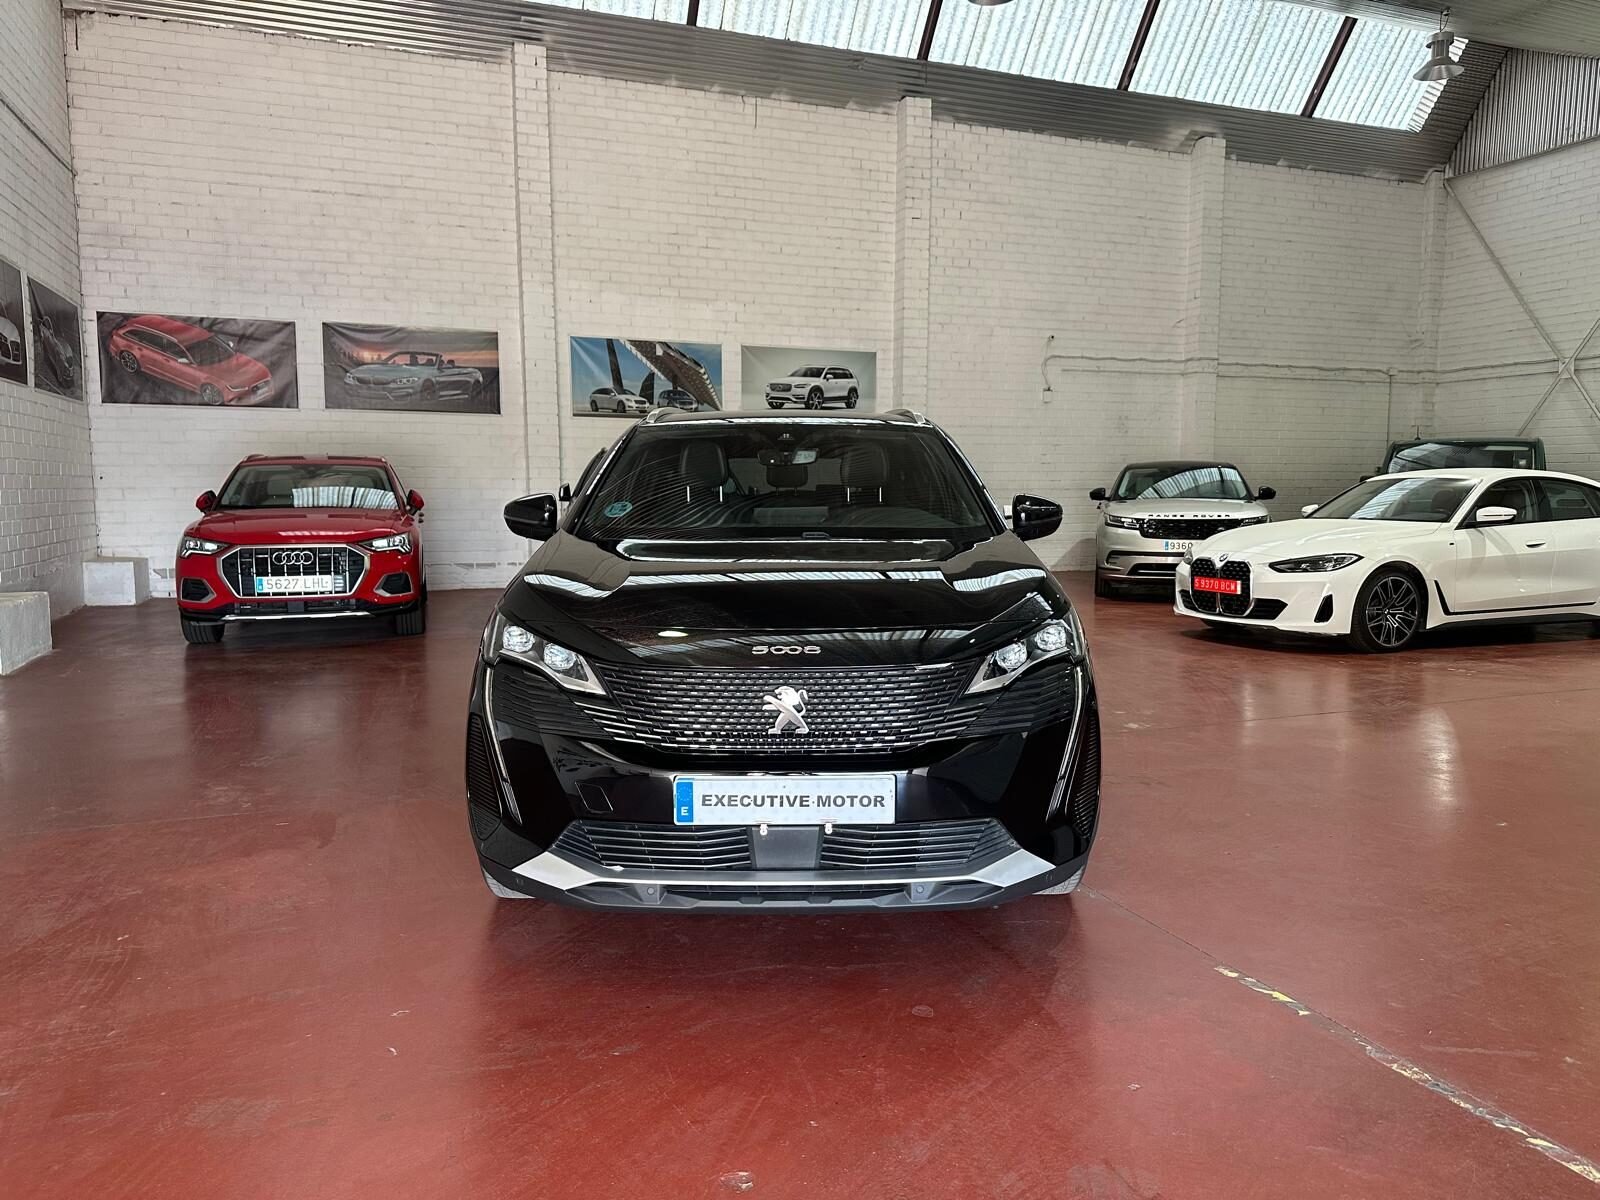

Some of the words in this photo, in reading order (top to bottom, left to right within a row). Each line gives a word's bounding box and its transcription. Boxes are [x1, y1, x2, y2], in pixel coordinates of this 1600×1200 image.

[266, 578, 299, 590] 5627
[303, 577, 328, 589] LHL
[1200, 580, 1219, 589] 9370
[752, 645, 821, 655] 5008
[701, 794, 811, 808] EXECUTIVE
[816, 794, 885, 808] MOTOR
[680, 806, 689, 816] E
